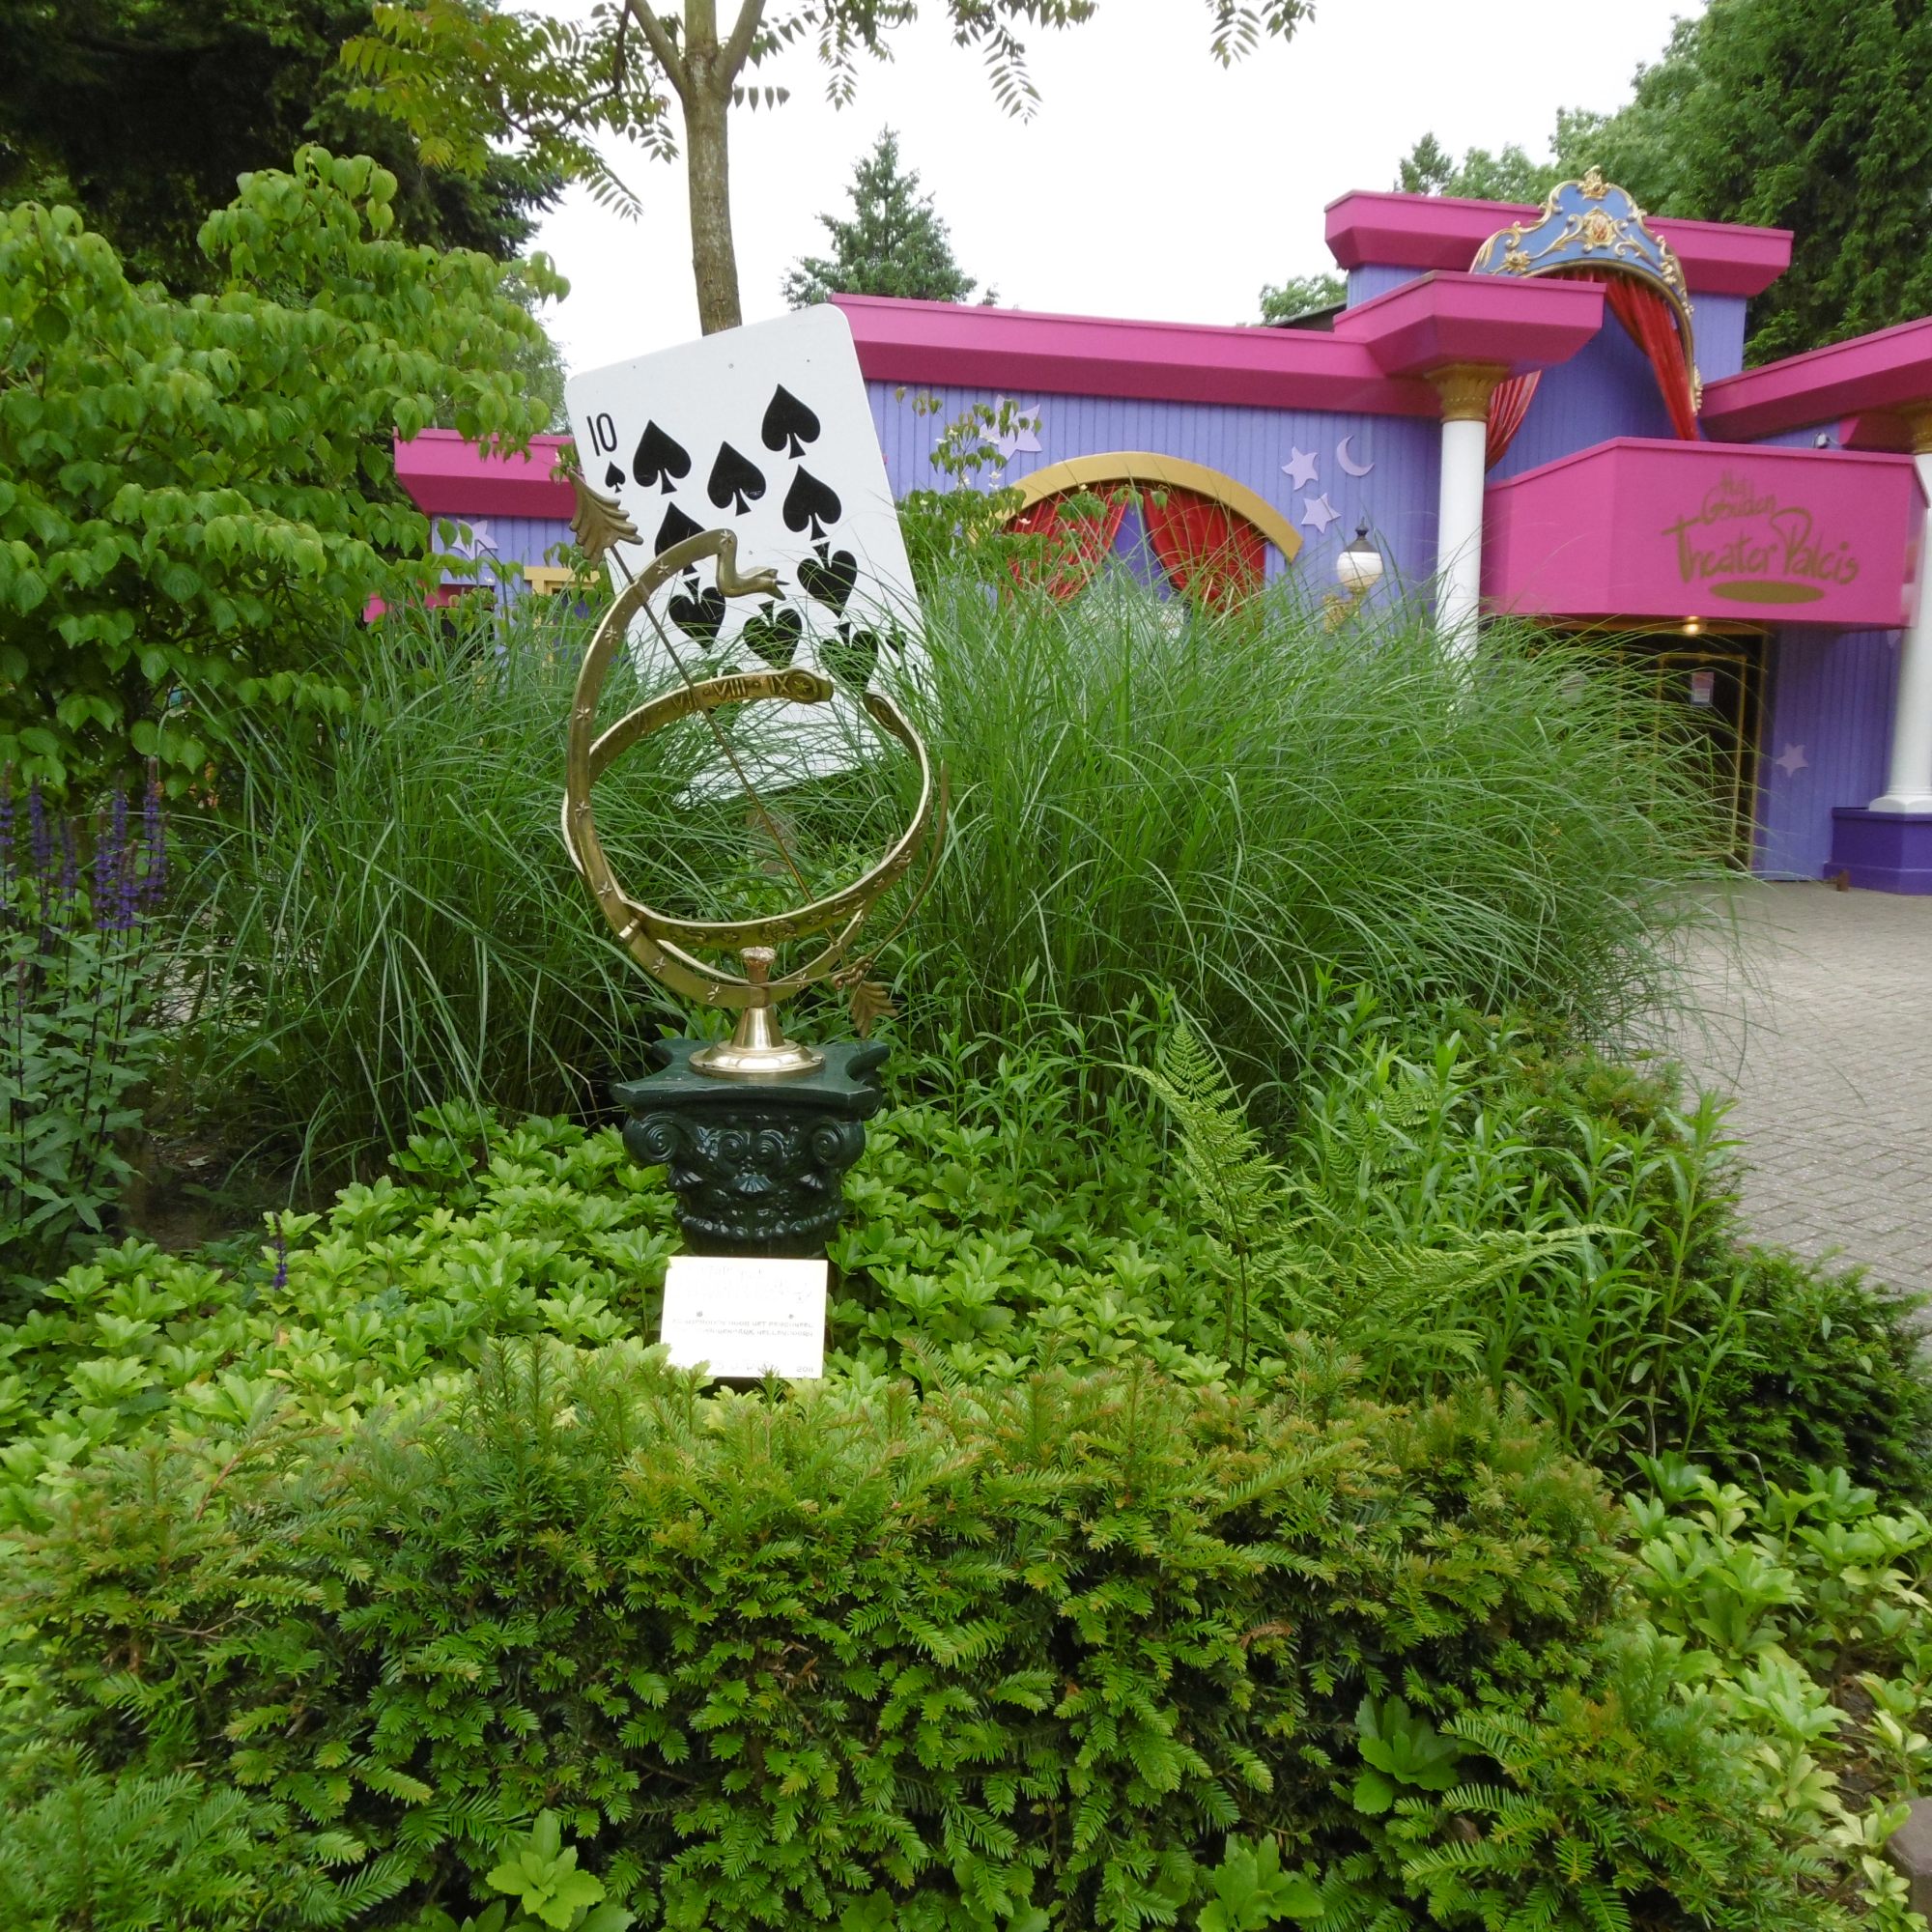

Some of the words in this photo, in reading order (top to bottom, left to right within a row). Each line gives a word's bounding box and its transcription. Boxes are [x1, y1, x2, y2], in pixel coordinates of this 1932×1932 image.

[586, 412, 617, 457] 10
[712, 677, 748, 697] VIII
[768, 675, 790, 695] IX
